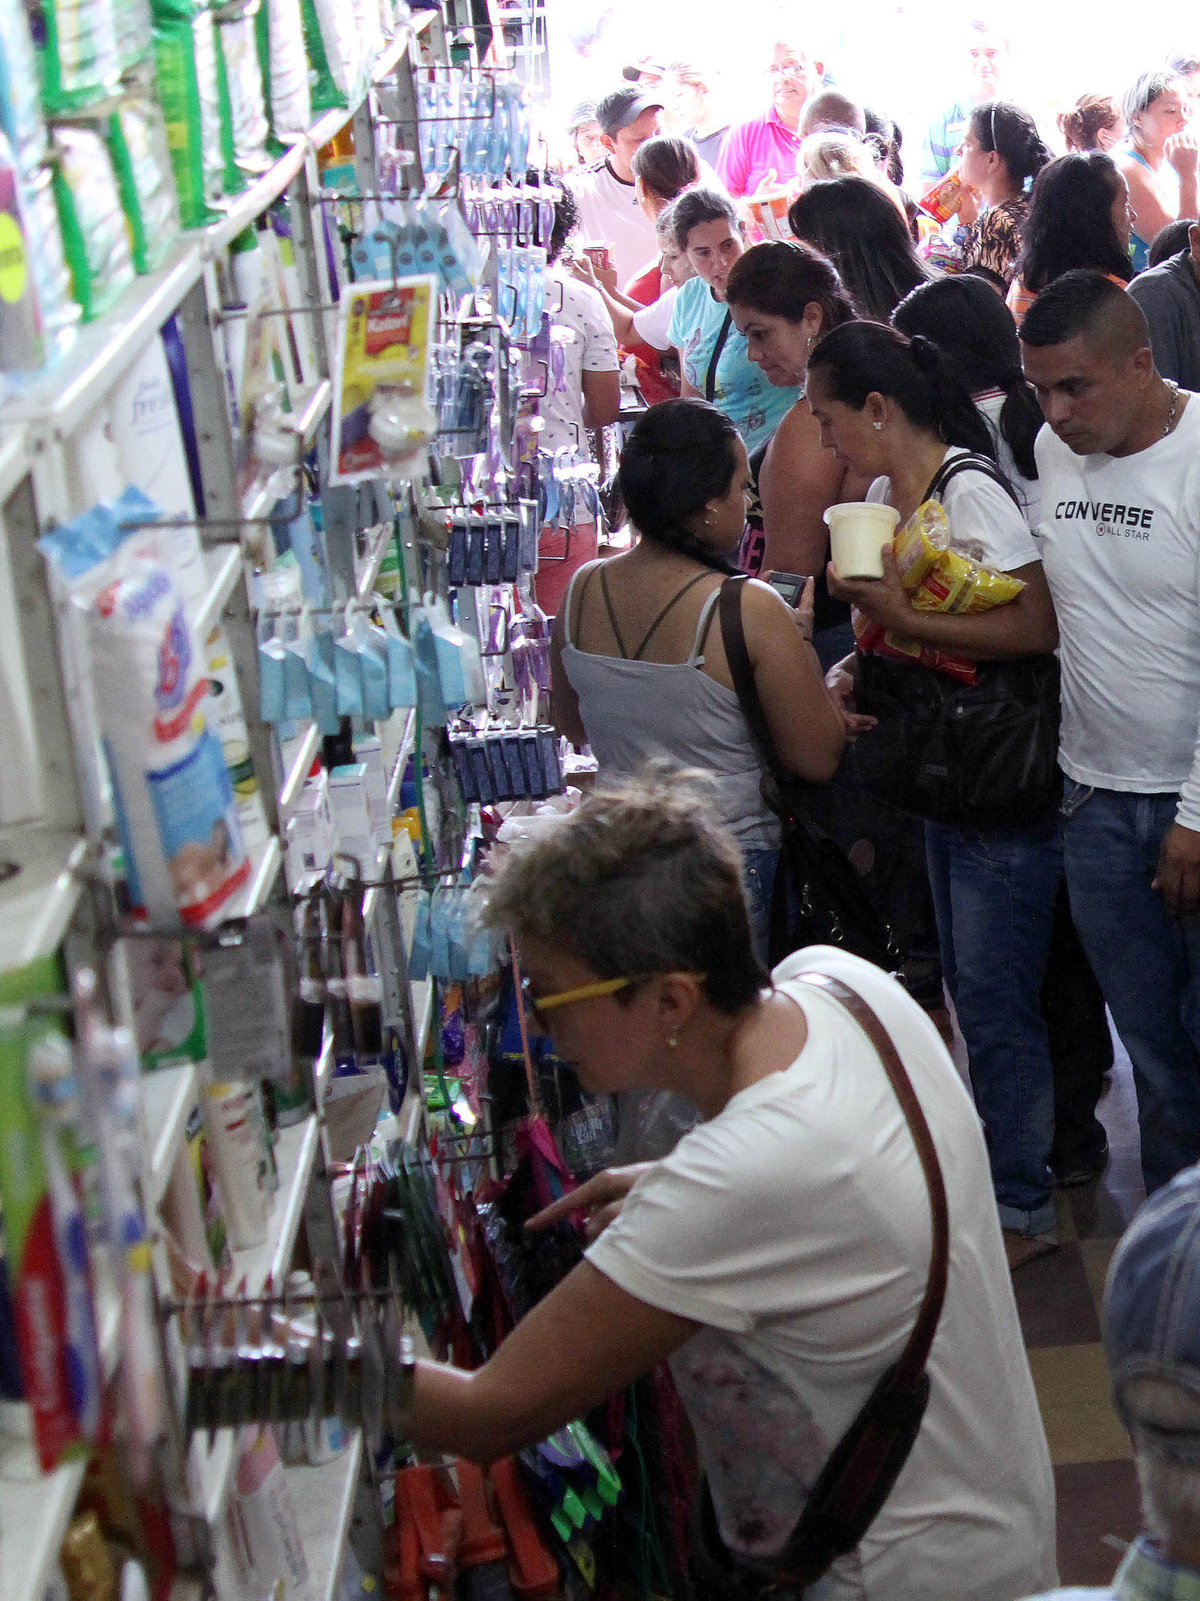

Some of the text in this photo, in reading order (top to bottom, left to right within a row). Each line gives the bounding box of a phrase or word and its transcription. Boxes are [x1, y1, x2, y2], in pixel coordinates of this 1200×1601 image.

[1055, 501, 1154, 529] CONVERSE
[1106, 526, 1150, 541] ALL STAR
